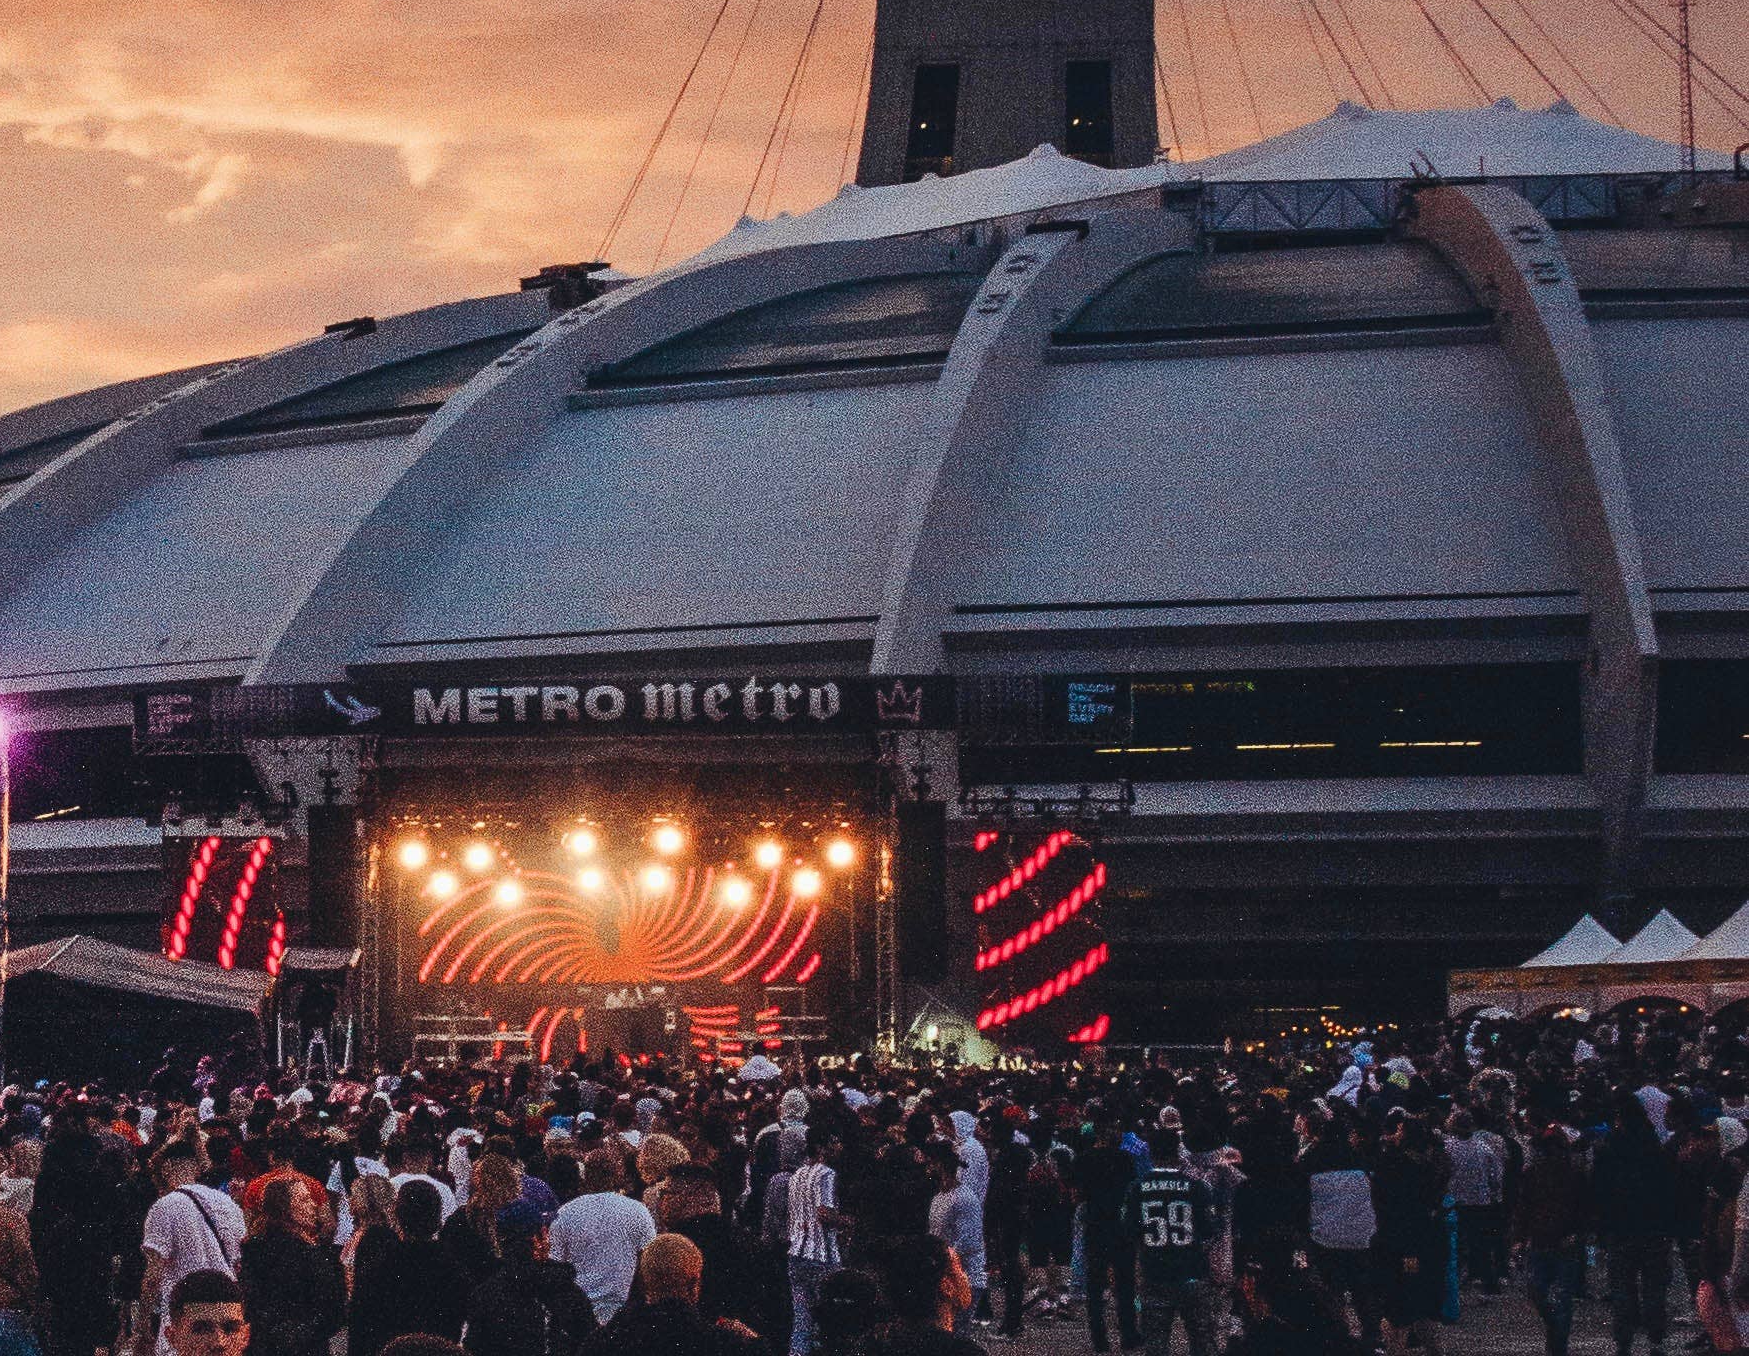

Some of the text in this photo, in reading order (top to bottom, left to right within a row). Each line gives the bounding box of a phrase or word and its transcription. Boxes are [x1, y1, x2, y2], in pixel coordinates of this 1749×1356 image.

[412, 676, 842, 726] METRO metro
[1141, 1200, 1194, 1247] 59
